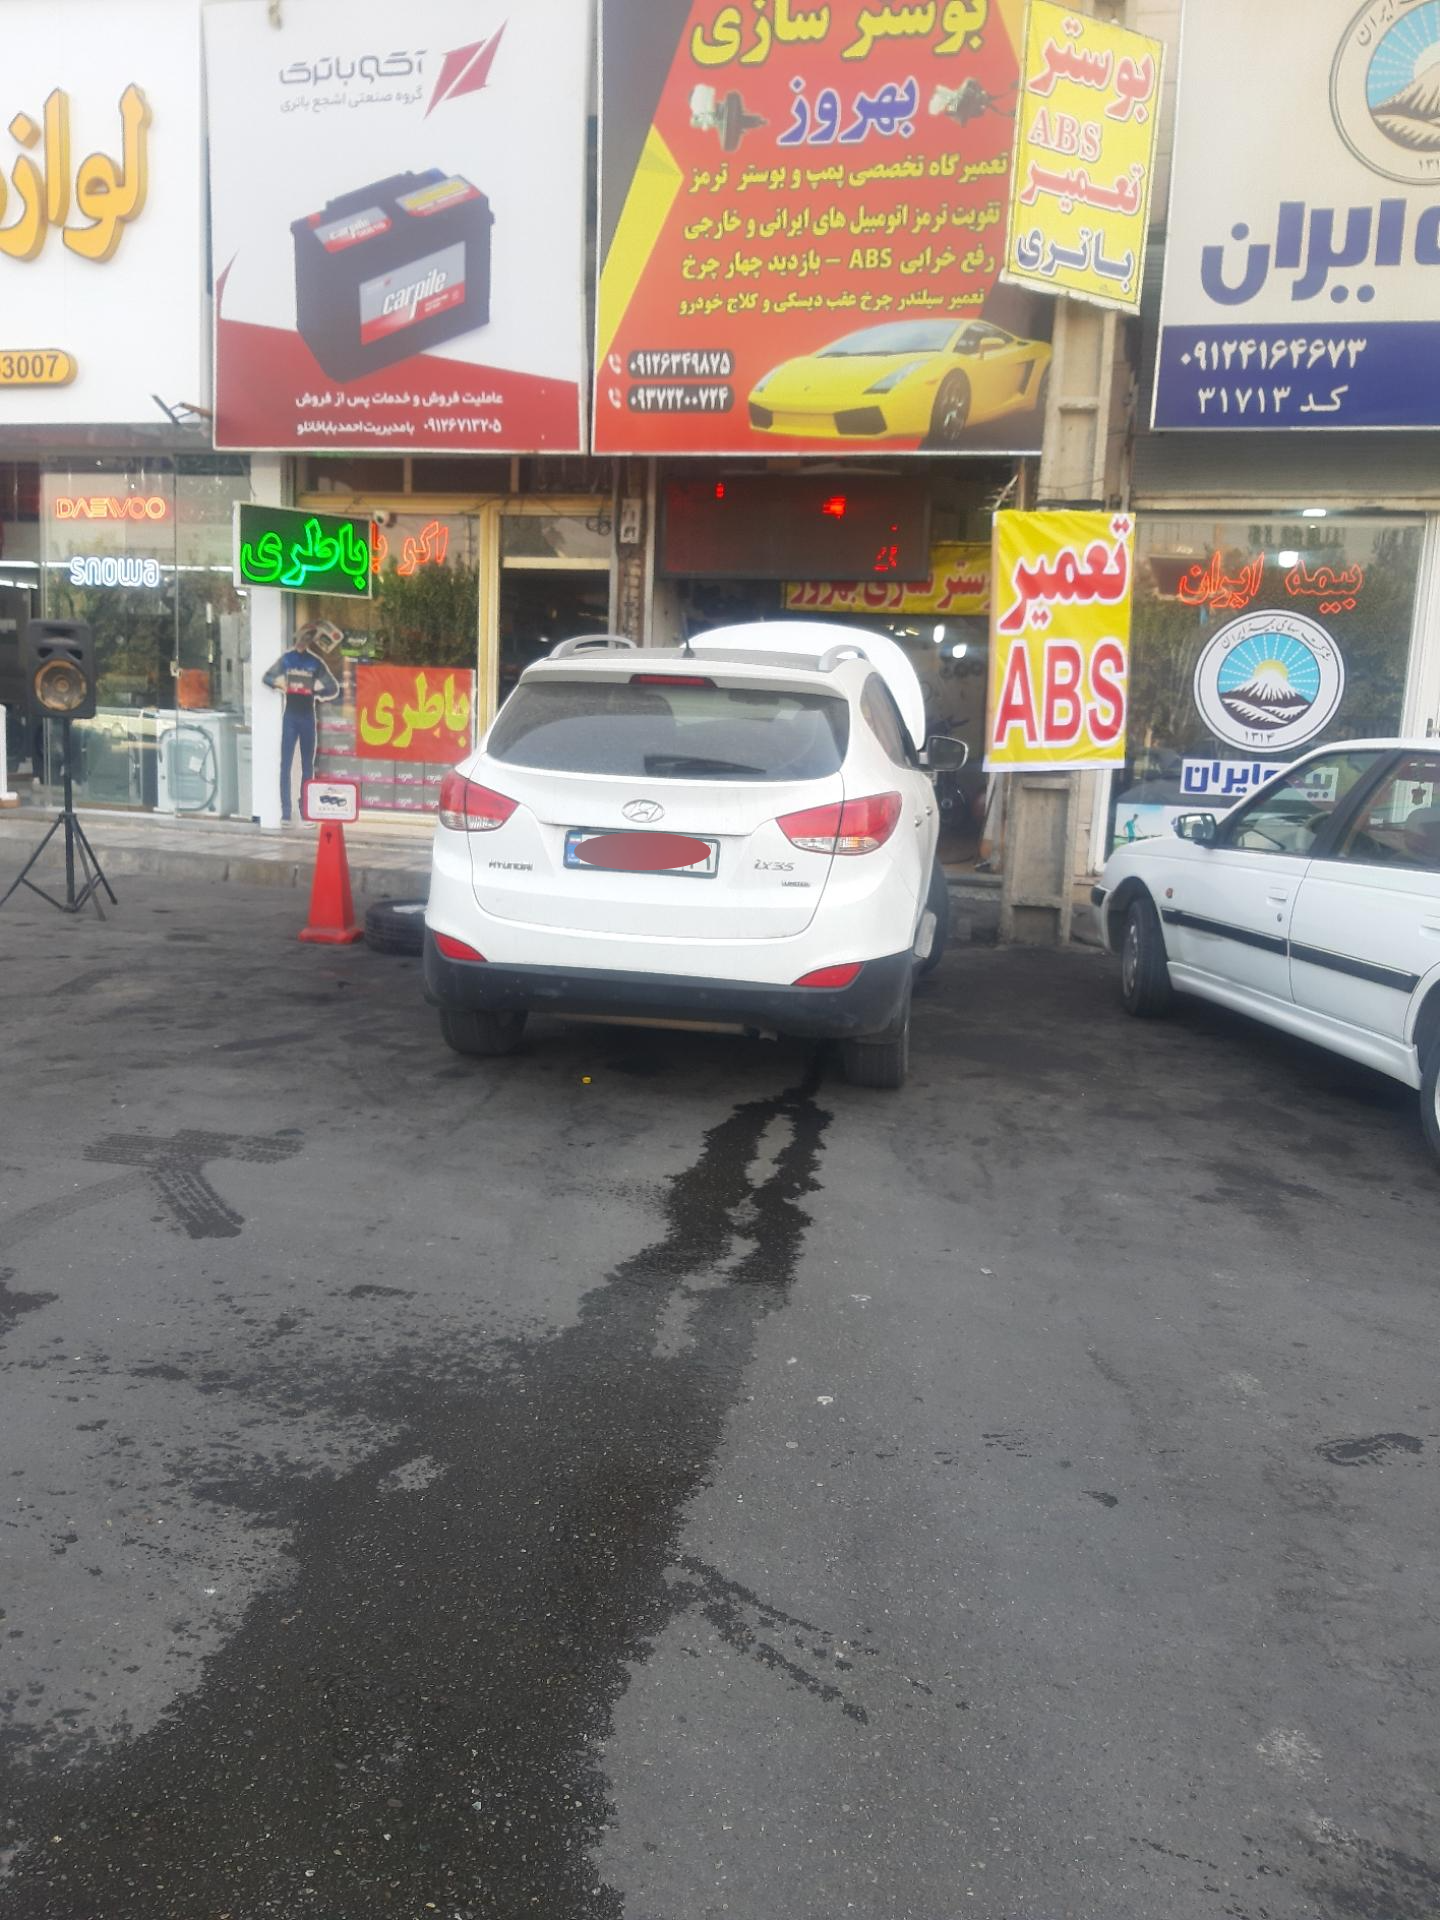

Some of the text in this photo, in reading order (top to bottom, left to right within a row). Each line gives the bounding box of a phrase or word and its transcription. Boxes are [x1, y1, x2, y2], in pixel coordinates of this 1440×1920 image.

[691, 0, 830, 64] سازی
[1028, 16, 1155, 122] بوستر
[777, 75, 919, 145] بهروز
[1028, 106, 1101, 161] ABS
[0, 82, 152, 263] لواز
[689, 162, 729, 193] ترمز
[736, 164, 787, 191] بوستر
[790, 167, 801, 190] و
[806, 164, 845, 190] پمپ
[849, 155, 924, 187] تخصصی
[1020, 160, 1145, 215] تعمیر
[684, 202, 1001, 239] تقویت ترمز اتومبیل های ایرانی و خارجی
[682, 253, 721, 280] چرخ
[724, 251, 763, 279] چهار
[768, 249, 821, 277] بازدید
[849, 247, 892, 269] ABS
[901, 245, 957, 274] خرابی
[961, 243, 996, 273] رفع
[1016, 227, 1134, 294] باتری
[1201, 198, 1407, 305] ایران
[383, 268, 447, 320] carpile
[679, 293, 723, 315] خودرو
[762, 299, 770, 313] و
[947, 288, 985, 310] تعمیر
[1198, 386, 1349, 414] کد ۳۱۷۱۳
[56, 496, 166, 520] DAEWOO
[240, 518, 369, 590] باطری
[999, 513, 1134, 634] تعمیر
[1178, 550, 1363, 614] بیمه ایران
[993, 638, 1128, 748] ABS
[360, 671, 470, 748] باطری
[1184, 762, 1261, 794] ایران
